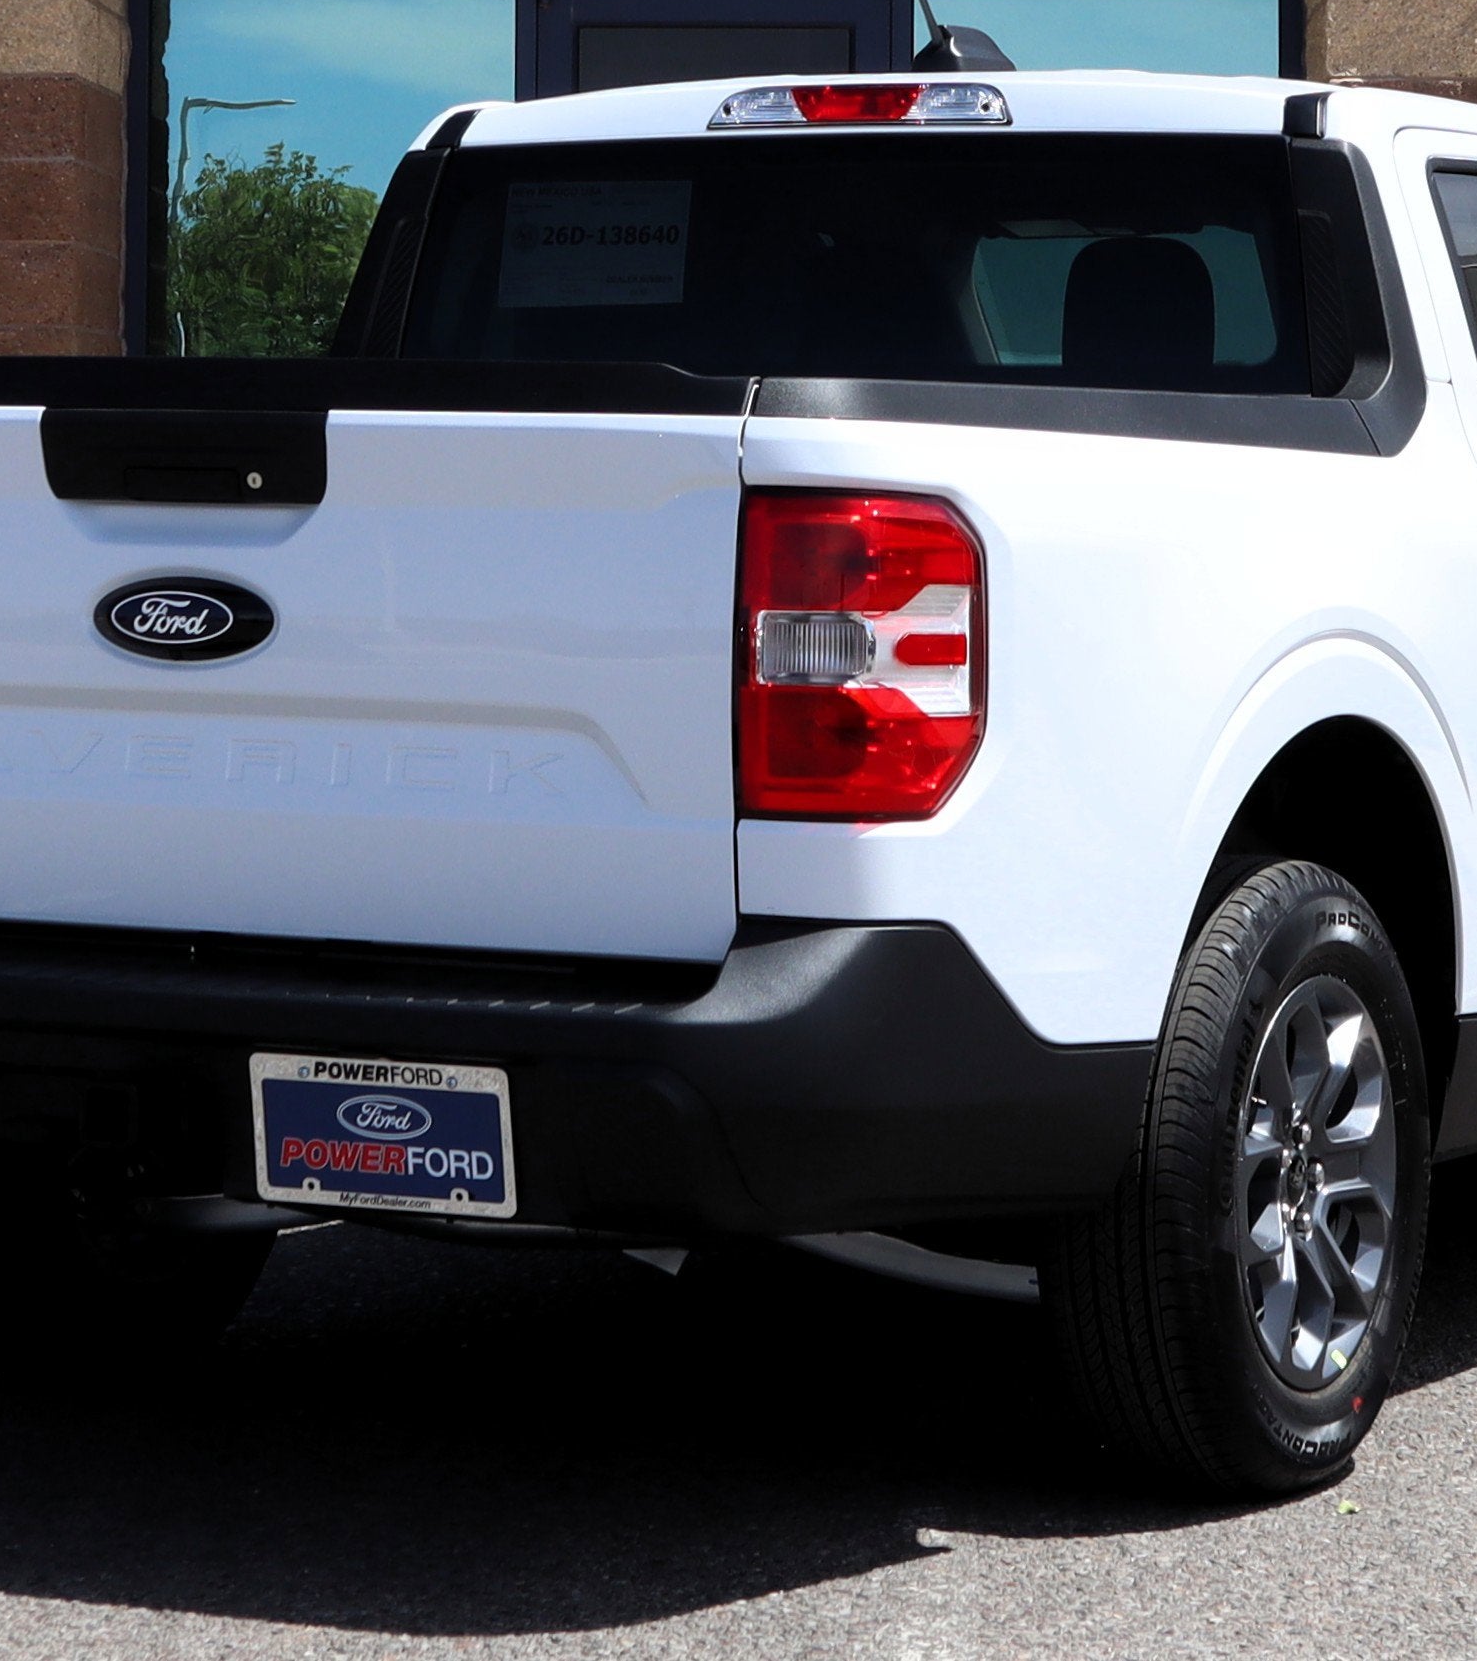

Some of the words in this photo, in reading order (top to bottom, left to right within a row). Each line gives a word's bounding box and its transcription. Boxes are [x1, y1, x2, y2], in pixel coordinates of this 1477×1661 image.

[542, 224, 681, 246] 26D-138640
[134, 597, 210, 635] Ford
[313, 1061, 443, 1086] POWERFORD
[356, 1101, 412, 1131] Ford
[280, 1137, 494, 1180] POWERFORD
